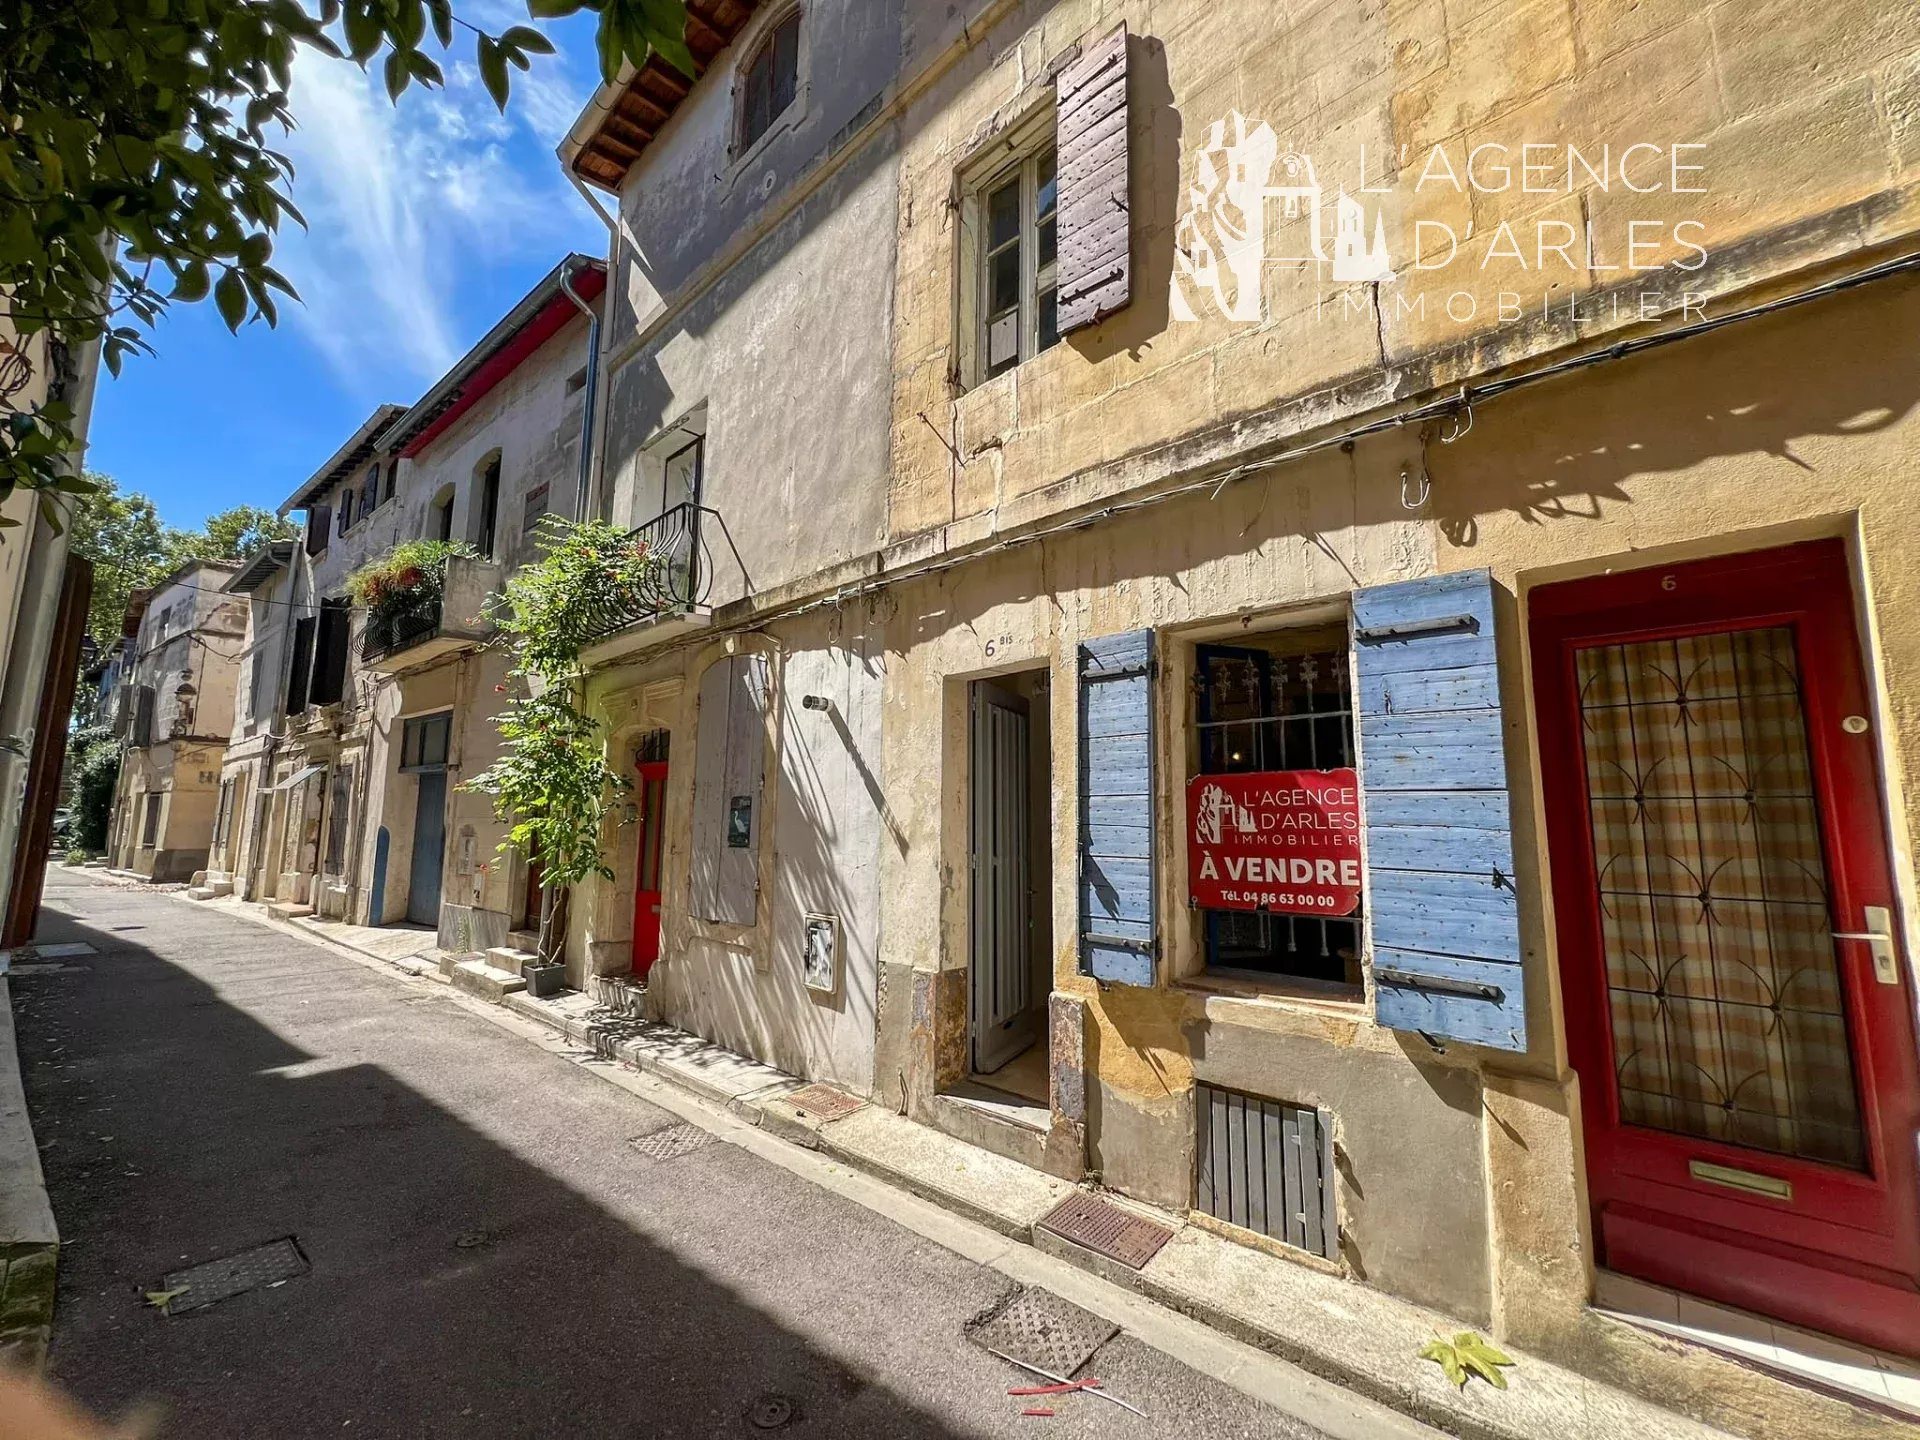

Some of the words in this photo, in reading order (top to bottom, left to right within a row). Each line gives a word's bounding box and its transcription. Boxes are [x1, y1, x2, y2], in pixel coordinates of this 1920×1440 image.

[1661, 575, 1677, 590] 6
[985, 639, 995, 657] 6
[1244, 787, 1355, 807] L'AGENCE
[1261, 812, 1357, 829] D'ARLES
[1234, 834, 1359, 845] IMMOBILIER
[1199, 850, 1219, 880] À
[1224, 856, 1360, 886] VENDRE
[1243, 892, 1258, 902] 04
[1261, 893, 1276, 903] 86
[1279, 894, 1294, 904] 63
[1297, 895, 1314, 905] 00
[1317, 896, 1334, 907] 00
